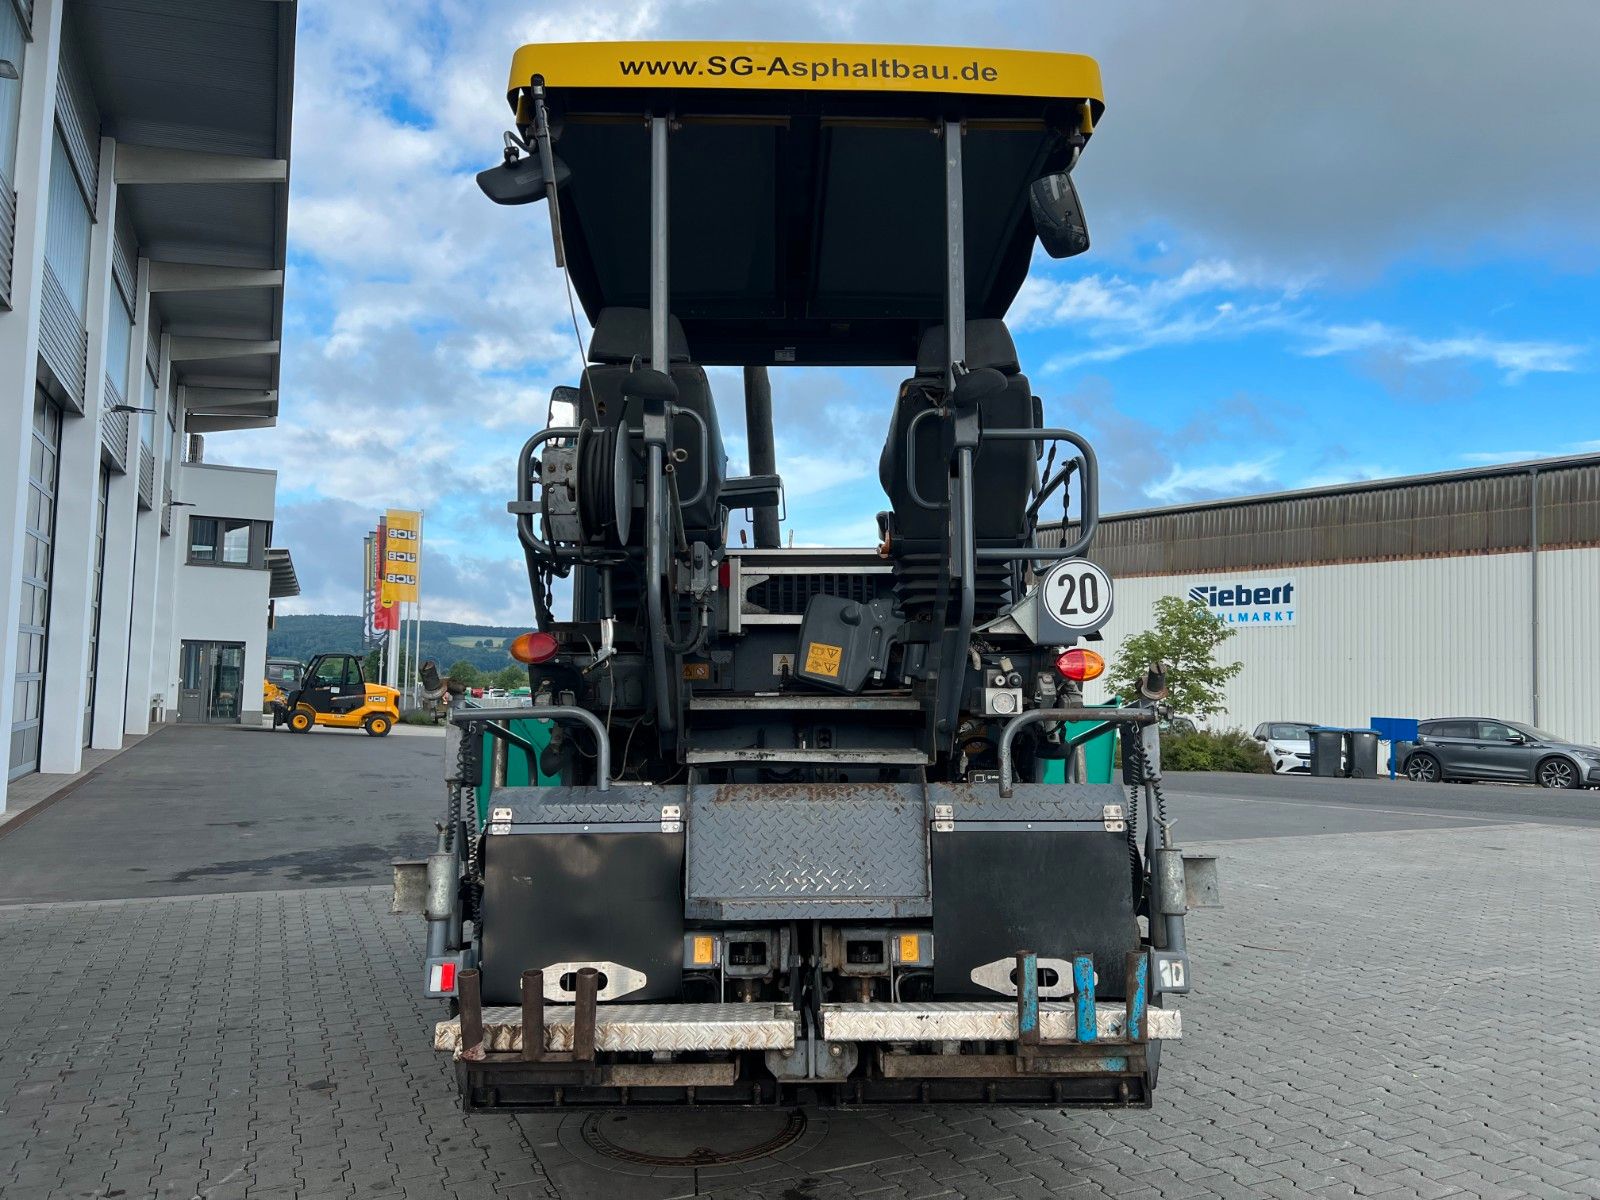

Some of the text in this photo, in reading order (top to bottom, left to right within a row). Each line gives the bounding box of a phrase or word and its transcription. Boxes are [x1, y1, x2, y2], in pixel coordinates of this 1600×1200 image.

[619, 55, 998, 82] www.SG-Asphaltbau.de
[1058, 572, 1098, 615] 20
[1189, 582, 1294, 607] Siebert
